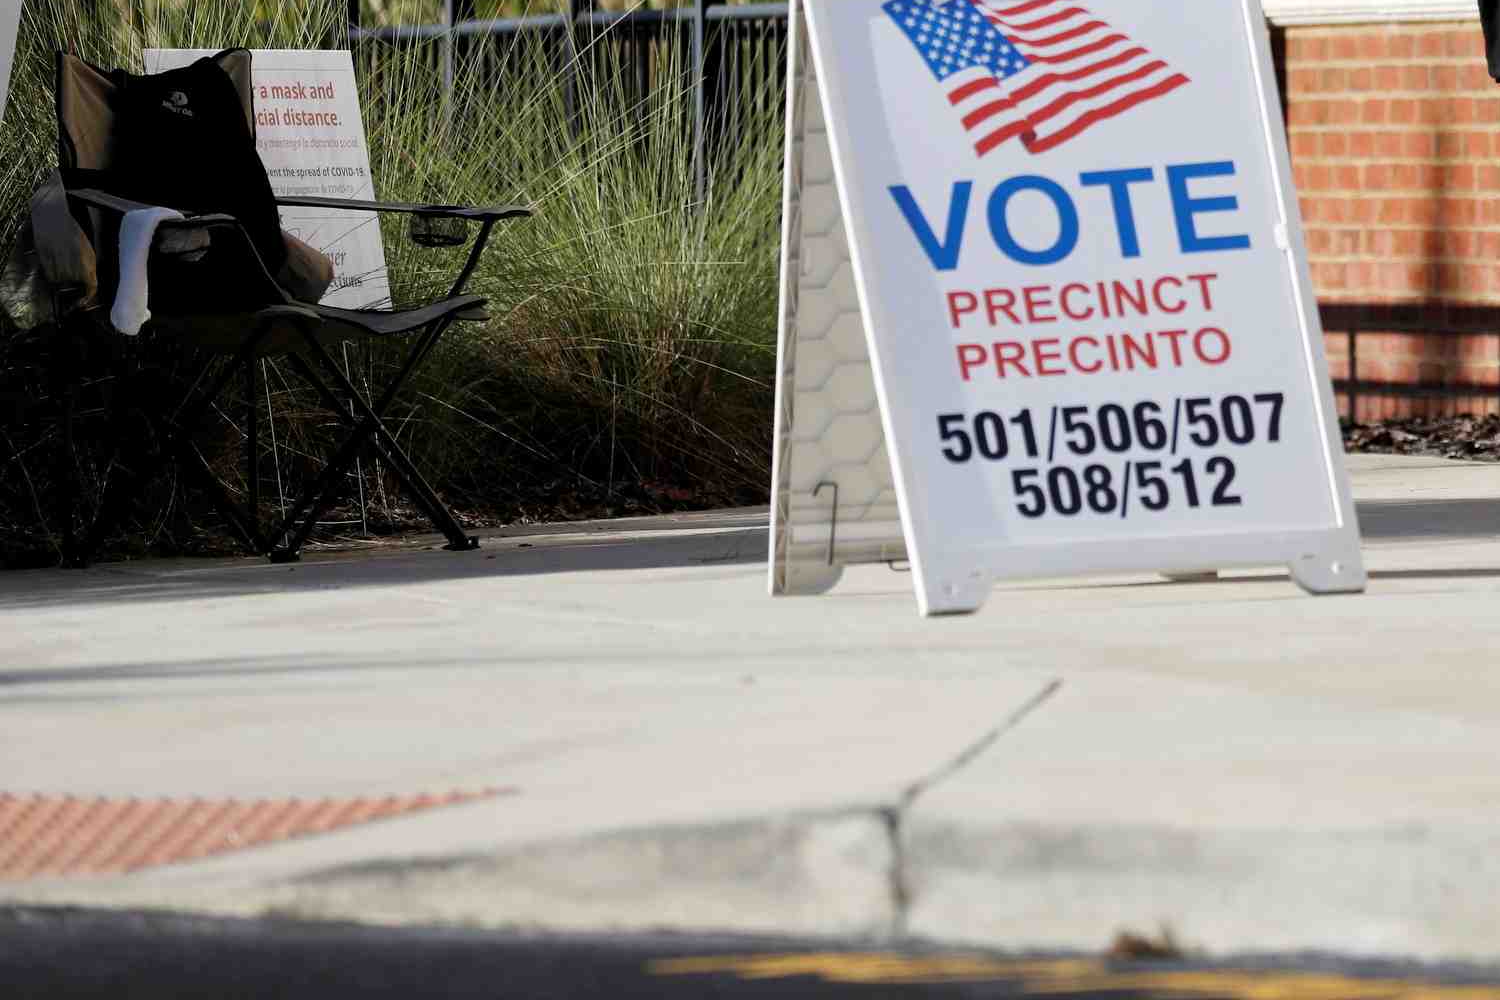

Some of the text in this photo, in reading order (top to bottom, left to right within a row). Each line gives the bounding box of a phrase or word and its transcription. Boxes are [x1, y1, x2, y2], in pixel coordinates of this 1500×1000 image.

[254, 108, 343, 126] cial distance.
[260, 85, 268, 99] a
[271, 81, 306, 99] mask
[310, 81, 336, 99] and
[284, 166, 296, 177] the
[297, 167, 322, 181] spread
[323, 167, 331, 177] of
[886, 160, 1251, 272] VOTE
[945, 273, 1218, 330] PRECINCT
[955, 327, 1232, 382] PRECINTO
[937, 392, 1285, 464] 501/506/507
[1011, 456, 1243, 519] 508/512
